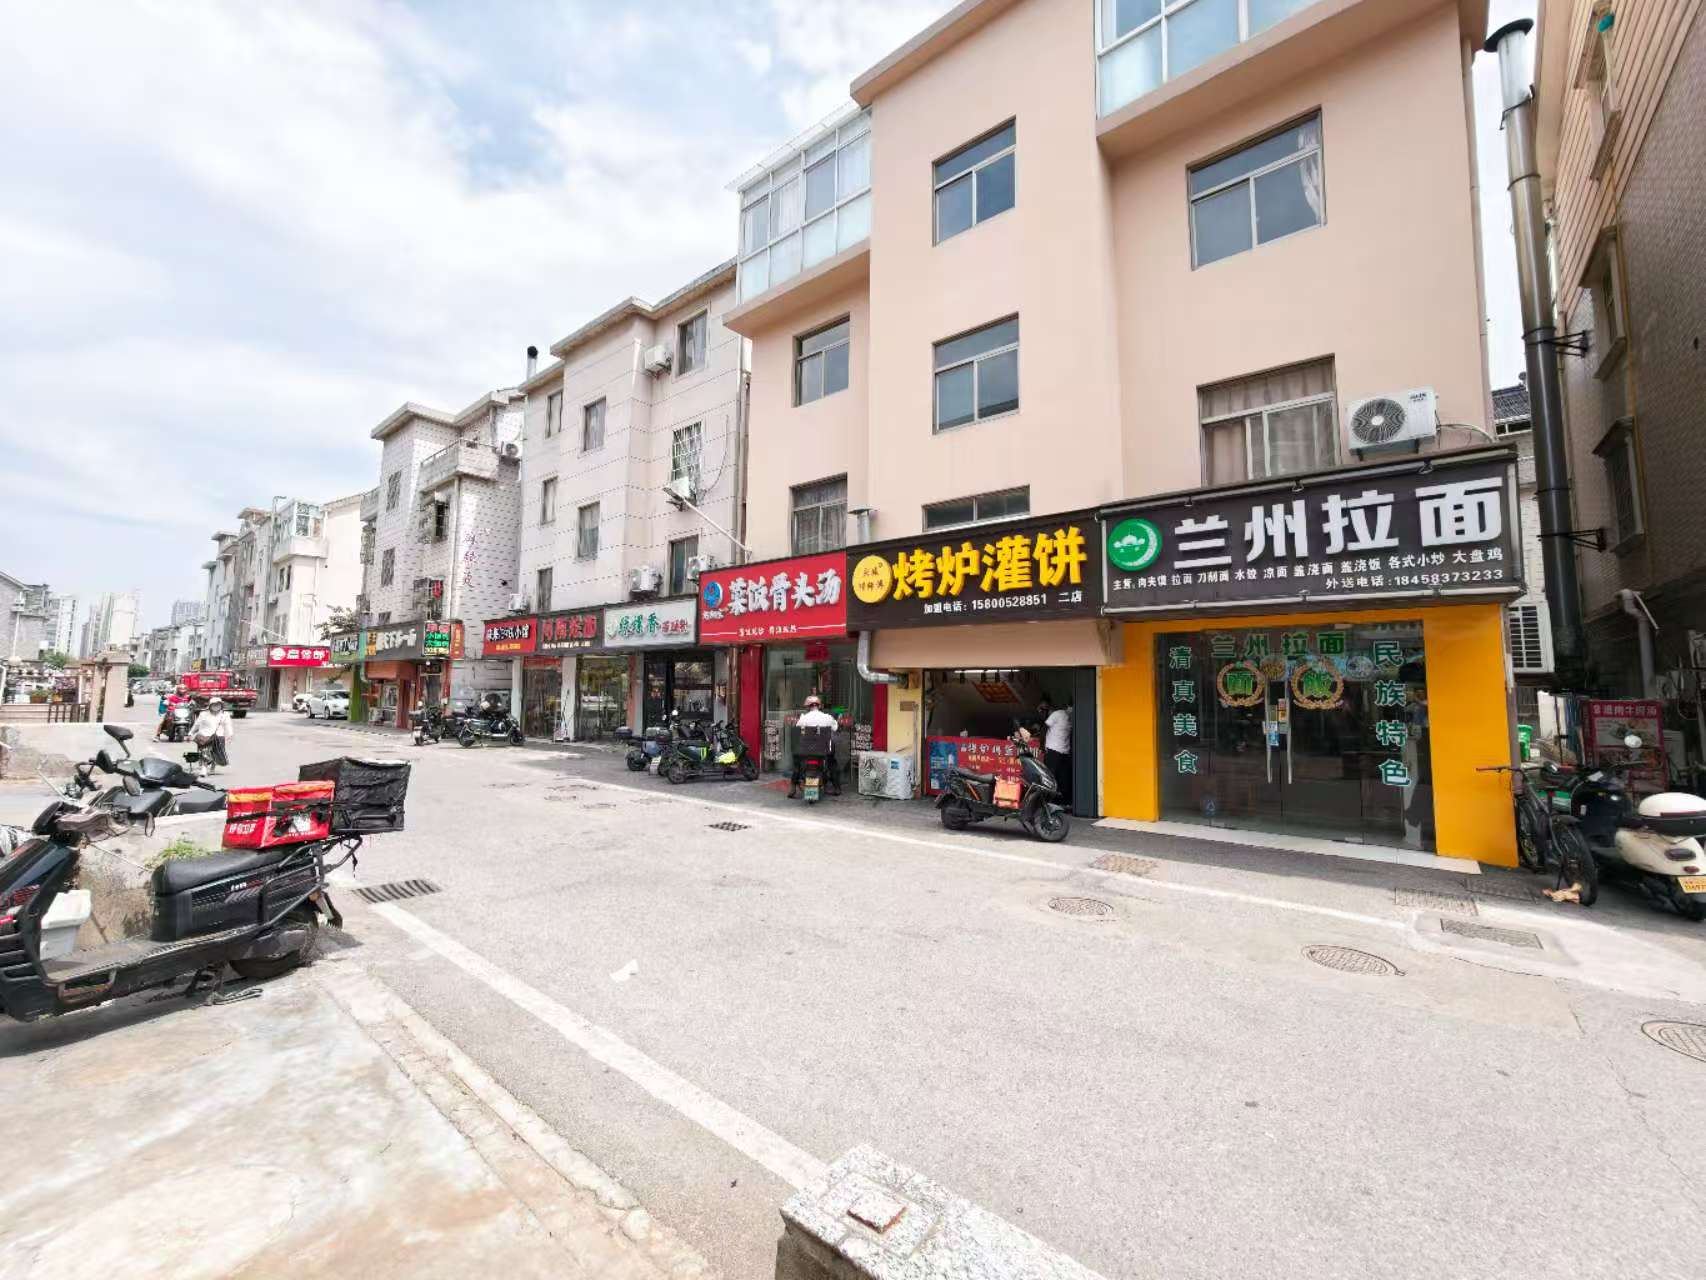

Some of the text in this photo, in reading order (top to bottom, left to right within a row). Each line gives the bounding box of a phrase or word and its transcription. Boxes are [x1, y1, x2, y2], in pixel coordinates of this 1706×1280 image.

[1173, 476, 1503, 570] 兰州拉面
[892, 526, 1087, 600] 烤炉灌饼
[1058, 589, 1083, 604] 二店
[1171, 573, 1192, 586] 拉面
[1197, 569, 1230, 584] 刀削面
[1234, 567, 1256, 581] 水饺
[1263, 565, 1288, 580] 凉面
[1293, 562, 1333, 577] 盖浇面
[1341, 557, 1381, 574] 盖浇饭
[1388, 551, 1445, 569] 各式小炒
[1452, 547, 1503, 564] 大盘鸡
[1211, 631, 1346, 658] 兰州拉面
[1168, 645, 1201, 775] 清真美食
[1373, 640, 1412, 787] 民族特色
